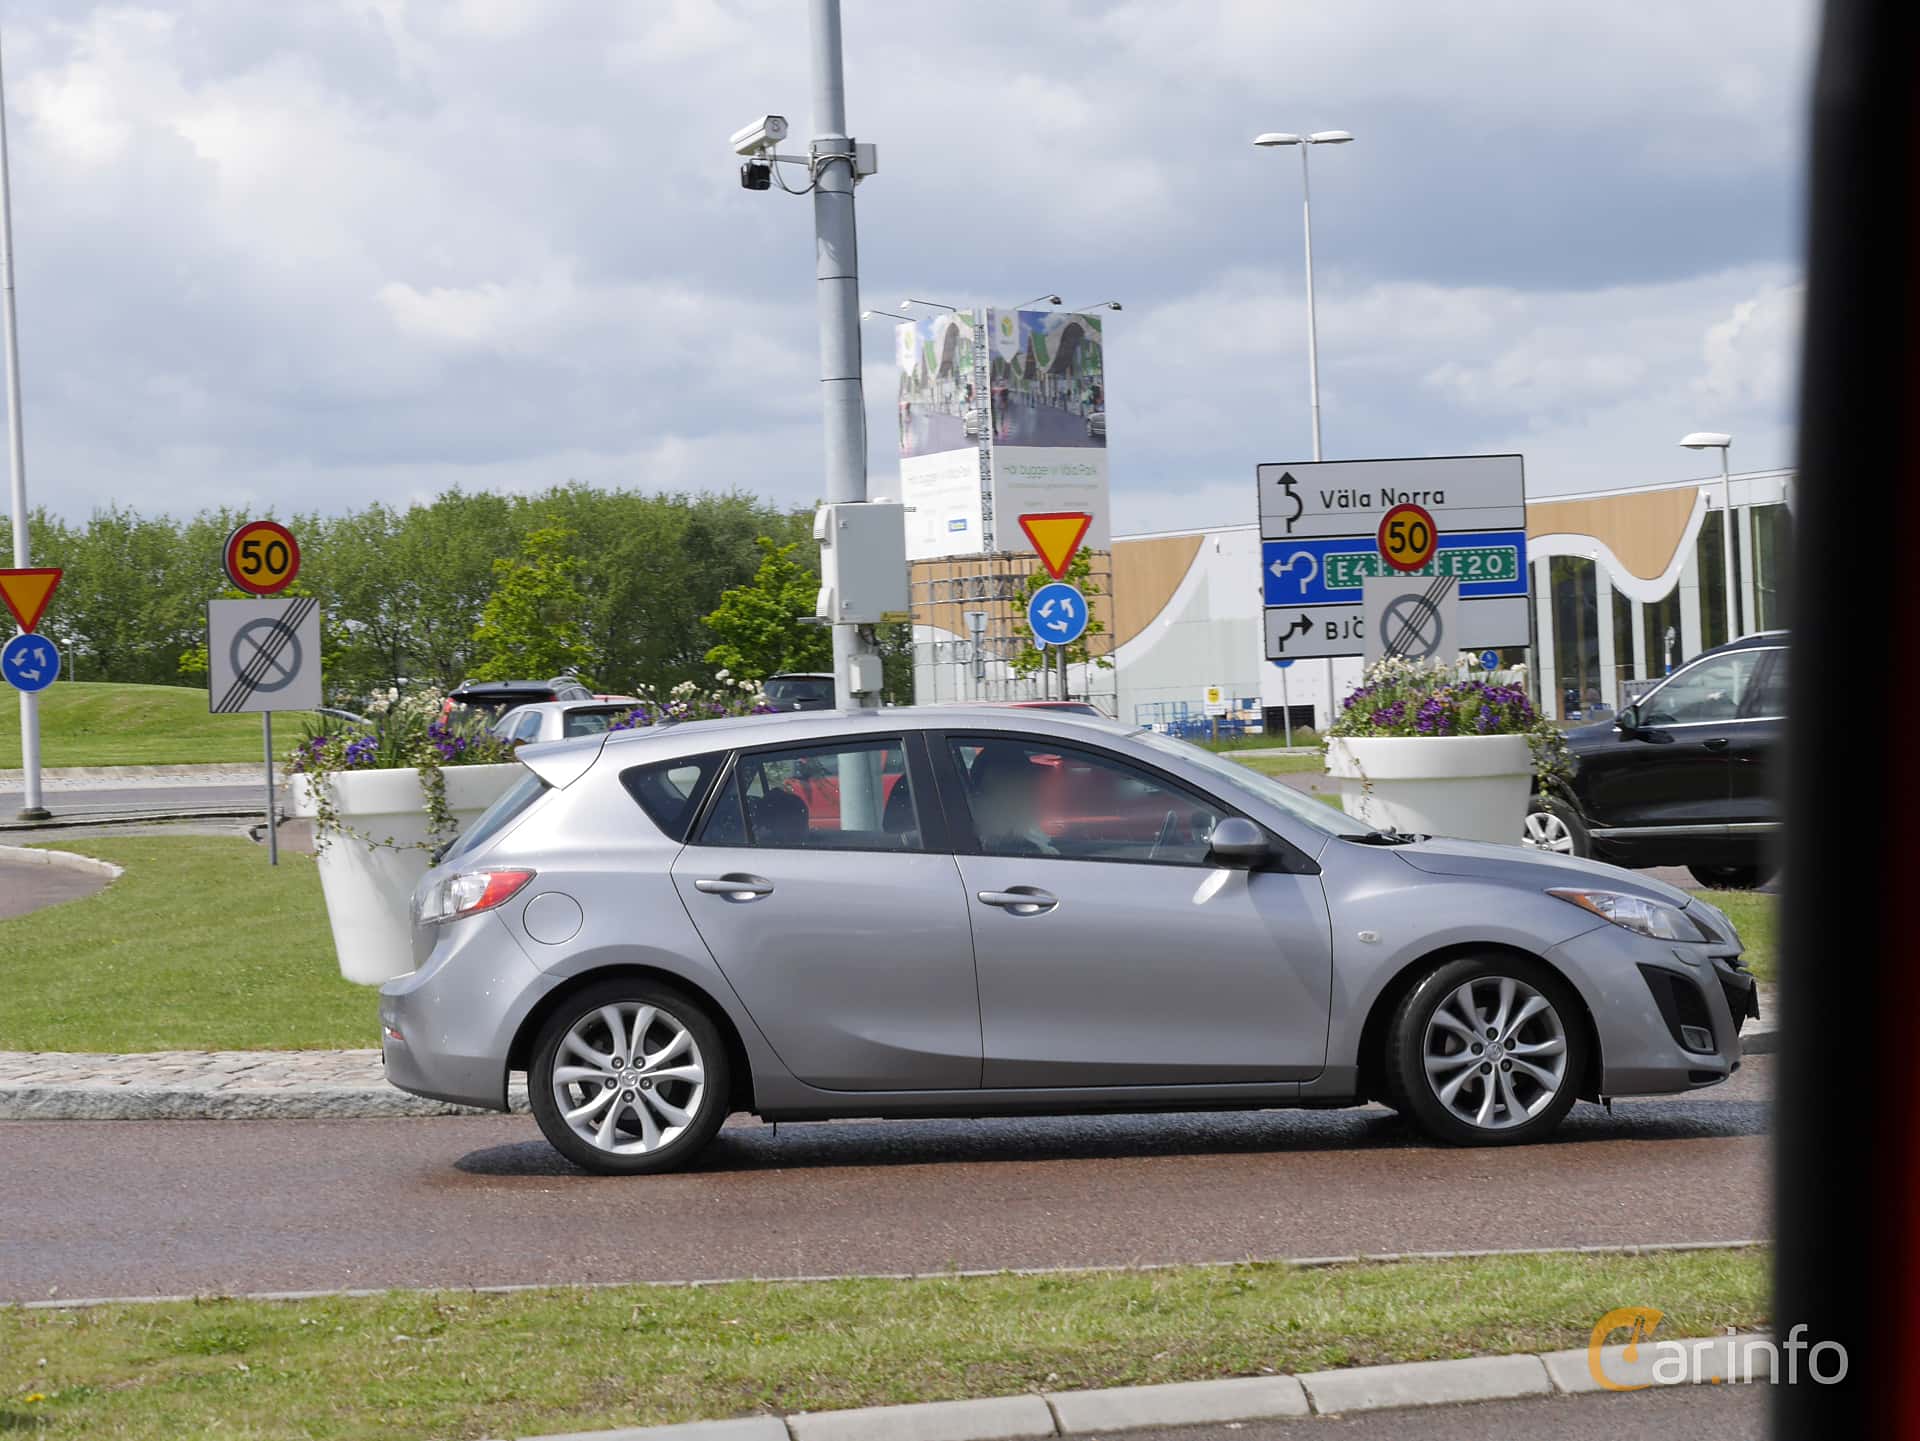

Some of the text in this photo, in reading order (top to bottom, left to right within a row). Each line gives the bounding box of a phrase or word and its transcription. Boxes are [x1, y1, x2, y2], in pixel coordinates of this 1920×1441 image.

[1320, 488, 1445, 509] Väla Norra
[1388, 521, 1428, 553] 50
[241, 540, 289, 575] 50
[1452, 556, 1503, 575] E20
[1337, 561, 1368, 581] E4
